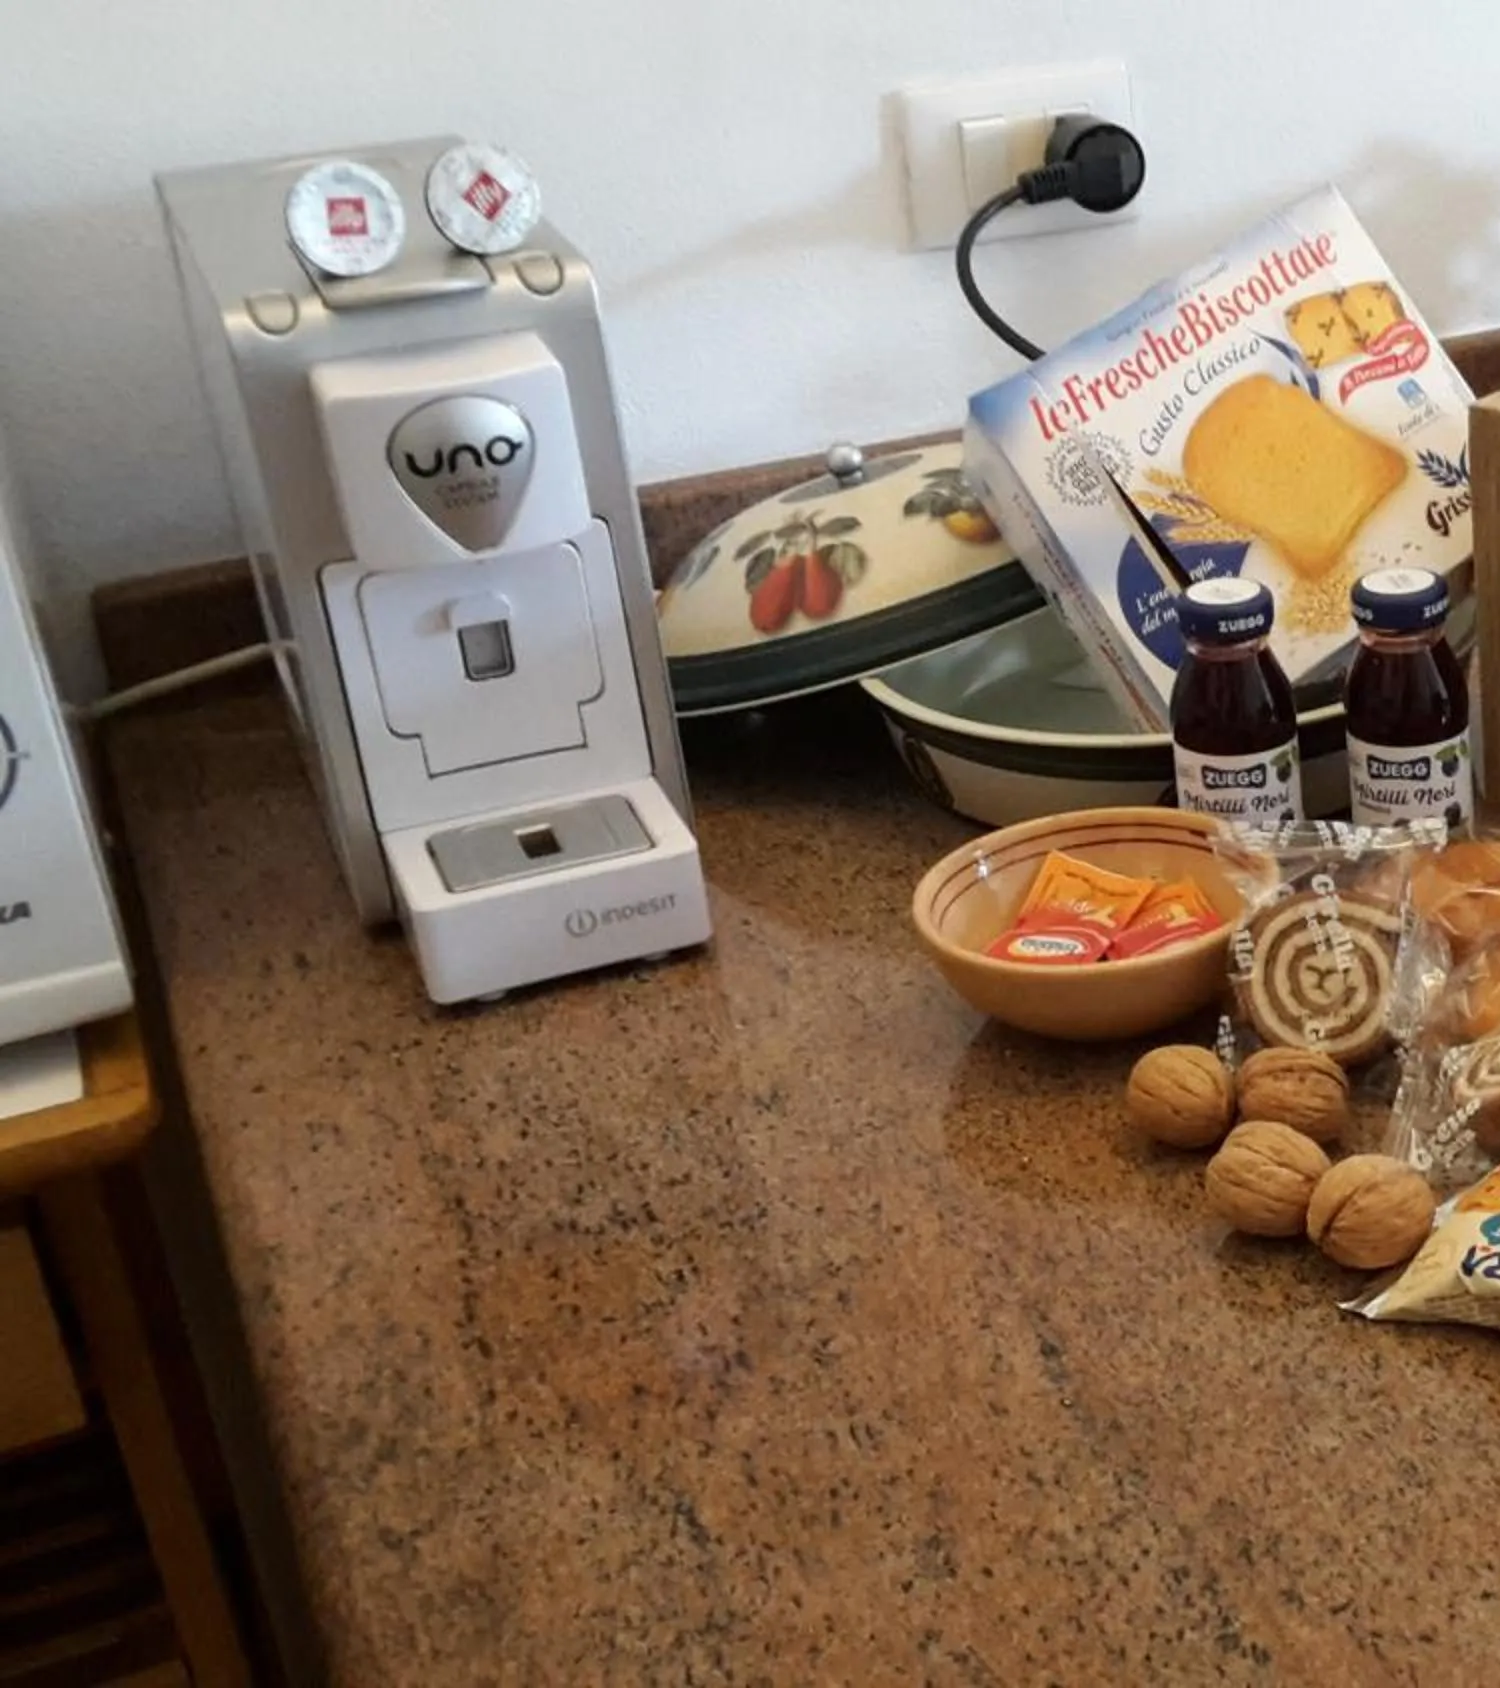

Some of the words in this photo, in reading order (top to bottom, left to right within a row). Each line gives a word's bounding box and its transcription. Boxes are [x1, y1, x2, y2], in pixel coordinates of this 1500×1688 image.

[1139, 395, 1184, 457] Gusto
[1184, 337, 1261, 397] Classico
[405, 434, 523, 478] uno
[1218, 613, 1265, 633] ZUEGG
[1204, 768, 1264, 786] ZUEGG
[1370, 761, 1428, 778] ZUEGG
